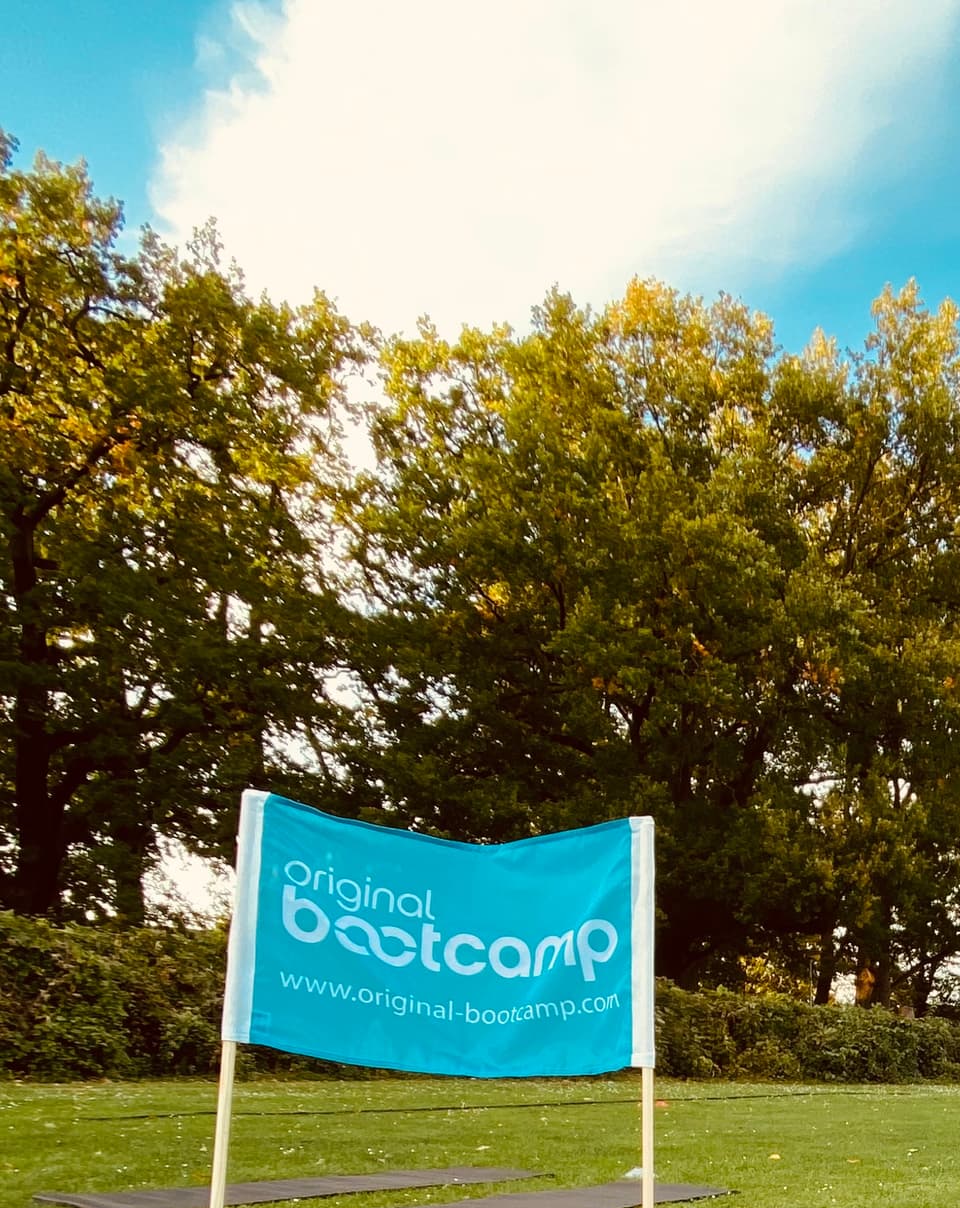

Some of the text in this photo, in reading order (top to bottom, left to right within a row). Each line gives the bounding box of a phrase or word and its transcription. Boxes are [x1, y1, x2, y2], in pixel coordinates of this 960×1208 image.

[284, 859, 435, 921] original
[282, 885, 618, 982] bootcamp
[279, 970, 620, 1025] www.original-bootcamp.com
